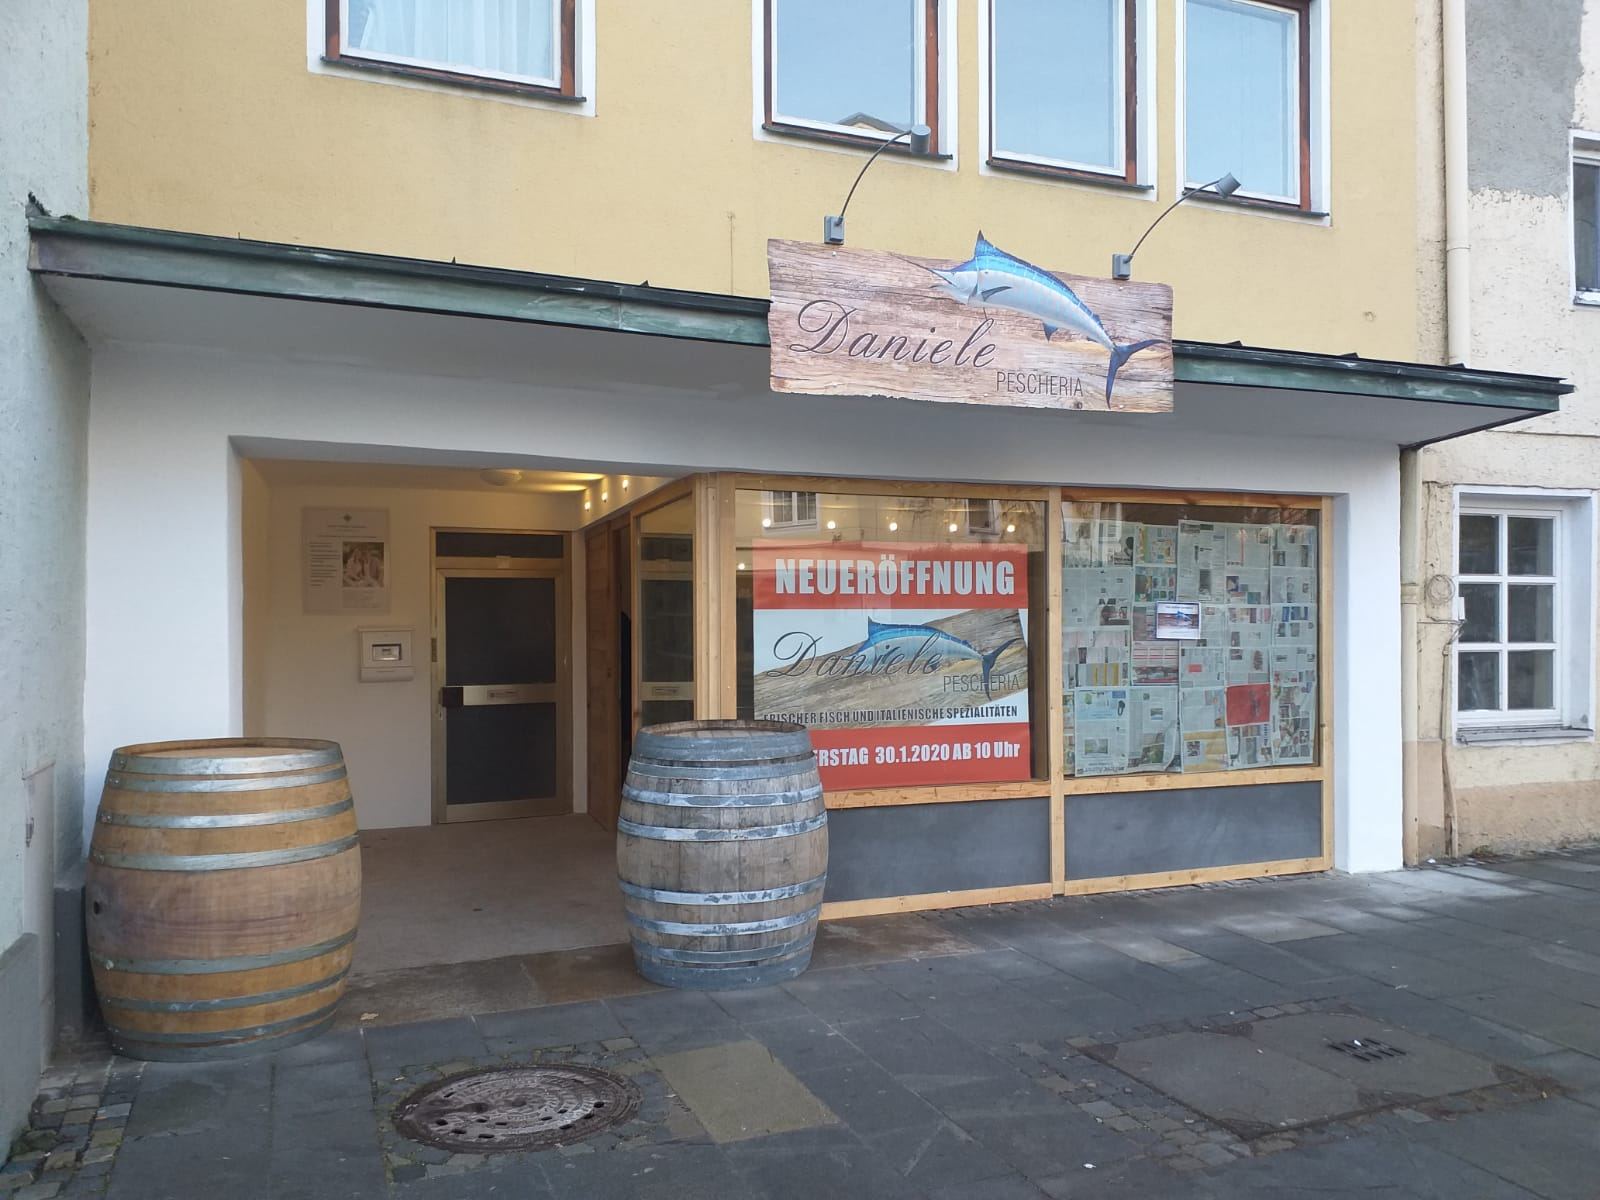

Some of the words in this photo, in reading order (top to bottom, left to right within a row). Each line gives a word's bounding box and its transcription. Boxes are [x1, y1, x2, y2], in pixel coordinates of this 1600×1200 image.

[789, 300, 998, 368] Daniele
[996, 371, 1084, 397] PESCHERIA
[775, 555, 1016, 595] NEUERÖFFNUNG
[767, 631, 942, 678] Daniele
[943, 673, 1021, 693] PESCHERIA
[819, 711, 850, 723] FISCH
[853, 710, 874, 722] UND
[876, 708, 945, 721] ITALIENISCHE
[946, 704, 1018, 719] SPEZIALITÄTEN
[875, 743, 949, 765] 30.1.2020
[952, 742, 972, 760] AB
[974, 741, 991, 759] 10
[993, 741, 1021, 759] Uhr
